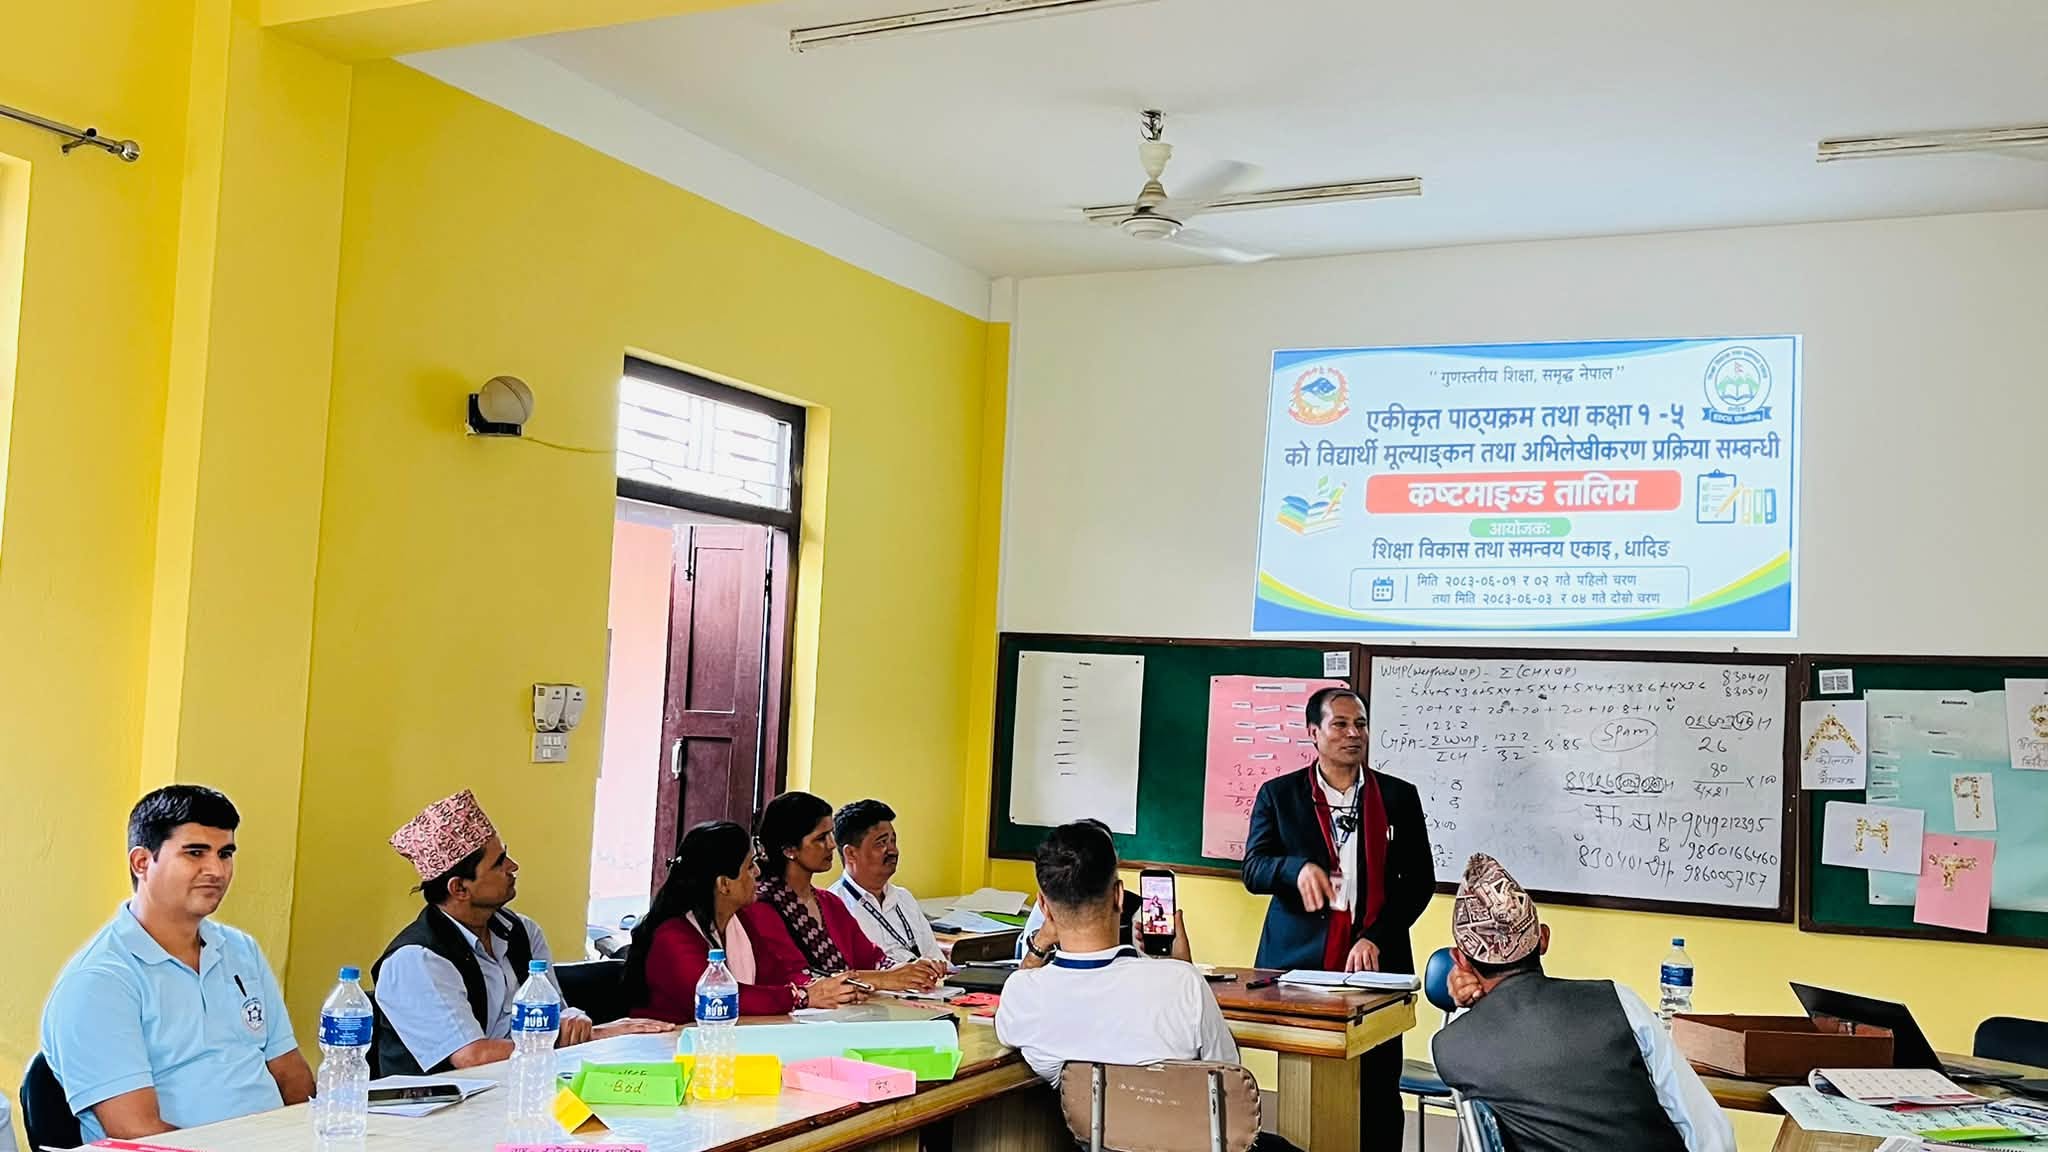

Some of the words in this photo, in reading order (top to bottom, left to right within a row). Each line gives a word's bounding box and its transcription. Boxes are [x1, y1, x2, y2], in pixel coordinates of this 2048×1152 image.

[1542, 367, 1574, 385] समृद्ध
[1366, 402, 1442, 436] एकीकृत
[1448, 406, 1536, 434] पाठ्यक्रम
[1541, 404, 1579, 428] तथा
[1586, 403, 1632, 429] कक्षा
[1637, 404, 1650, 425] १
[1284, 441, 1311, 467] को
[1316, 438, 1379, 466] विद्यार्थी
[1384, 443, 1476, 470] मूल्याङ्कन
[1481, 442, 1516, 463] तथा
[1521, 434, 1648, 462] अभिलेखीकरण
[1652, 433, 1711, 462] प्रक्रिया
[1716, 431, 1781, 459] सम्बन्धी
[1408, 480, 1547, 511] कष्टमाइज्ड
[1553, 473, 1639, 506] तालिम
[1371, 537, 1414, 560] शिक्षा
[1419, 537, 1471, 559] विकास
[1474, 541, 1505, 559] तथा
[1508, 540, 1565, 558] समन्वय
[1417, 572, 1439, 587] मिति
[1522, 575, 1530, 587] र
[1534, 574, 1549, 586] ०२
[1555, 571, 1571, 586] गते
[1577, 571, 1609, 587] पहिलो
[1612, 574, 1638, 586] चरण
[1431, 594, 1451, 605] तथा
[1455, 590, 1476, 605] मिति
[1560, 592, 1568, 604] र
[1591, 589, 1606, 604] गते
[1637, 592, 1661, 605] चरण
[705, 1004, 729, 1017] RUBY
[524, 1016, 550, 1028] RUBY
